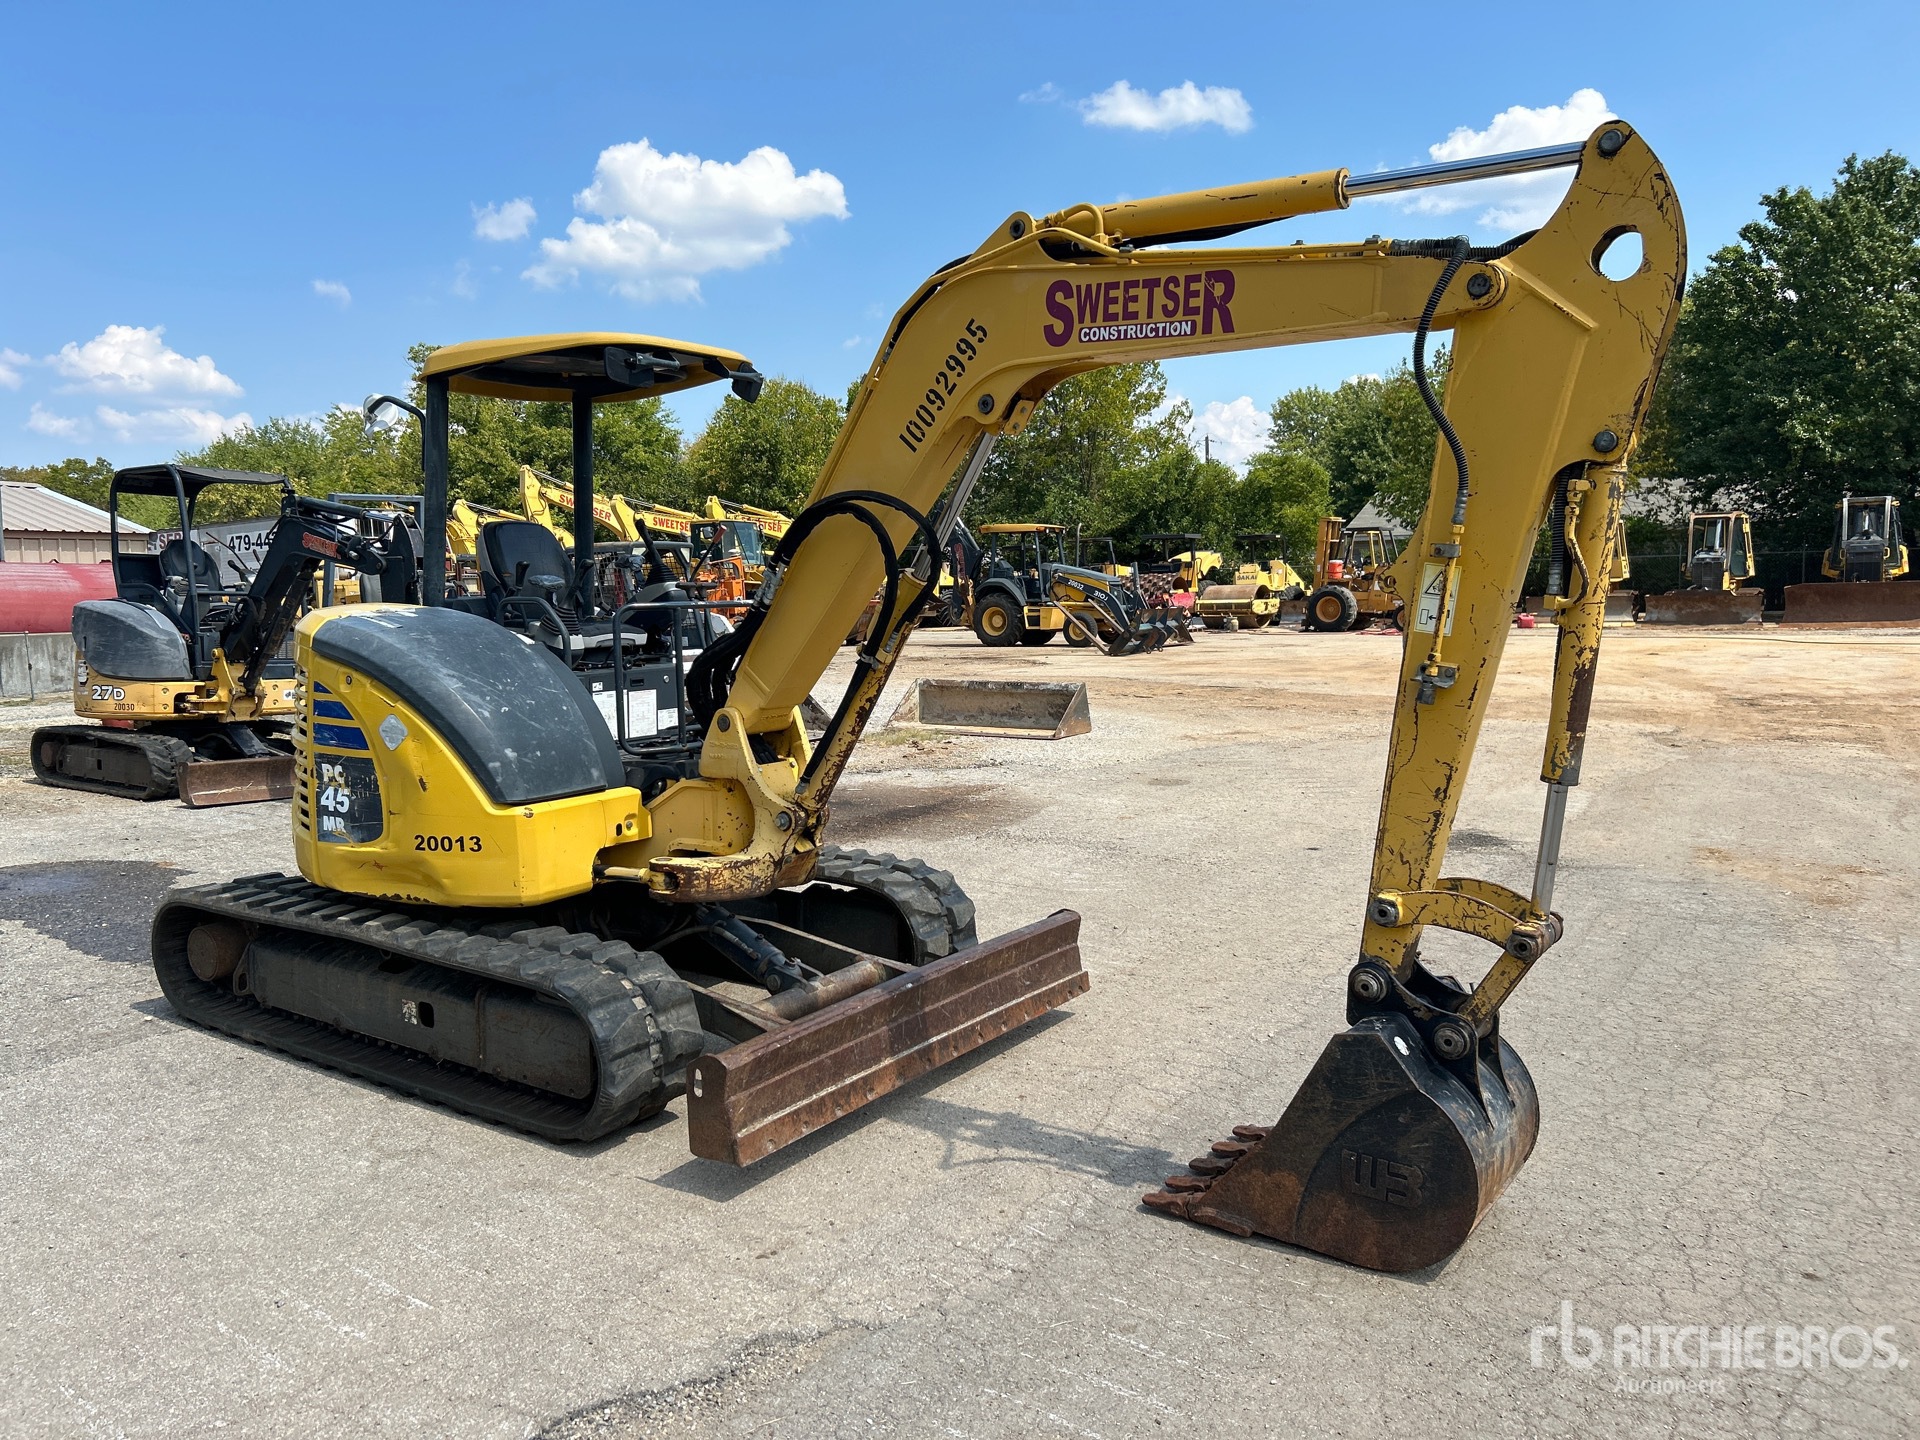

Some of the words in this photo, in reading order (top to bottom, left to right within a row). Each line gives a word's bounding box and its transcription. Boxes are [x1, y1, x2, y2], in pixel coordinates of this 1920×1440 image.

[1043, 269, 1236, 347] SWEETSER
[1080, 320, 1192, 342] CONSTRUCTION
[898, 317, 989, 453] 10092995
[652, 516, 691, 532] SWEETSE
[114, 702, 135, 711] 20030
[320, 786, 350, 813] 45
[323, 815, 347, 833] MR
[414, 834, 483, 853] 20013
